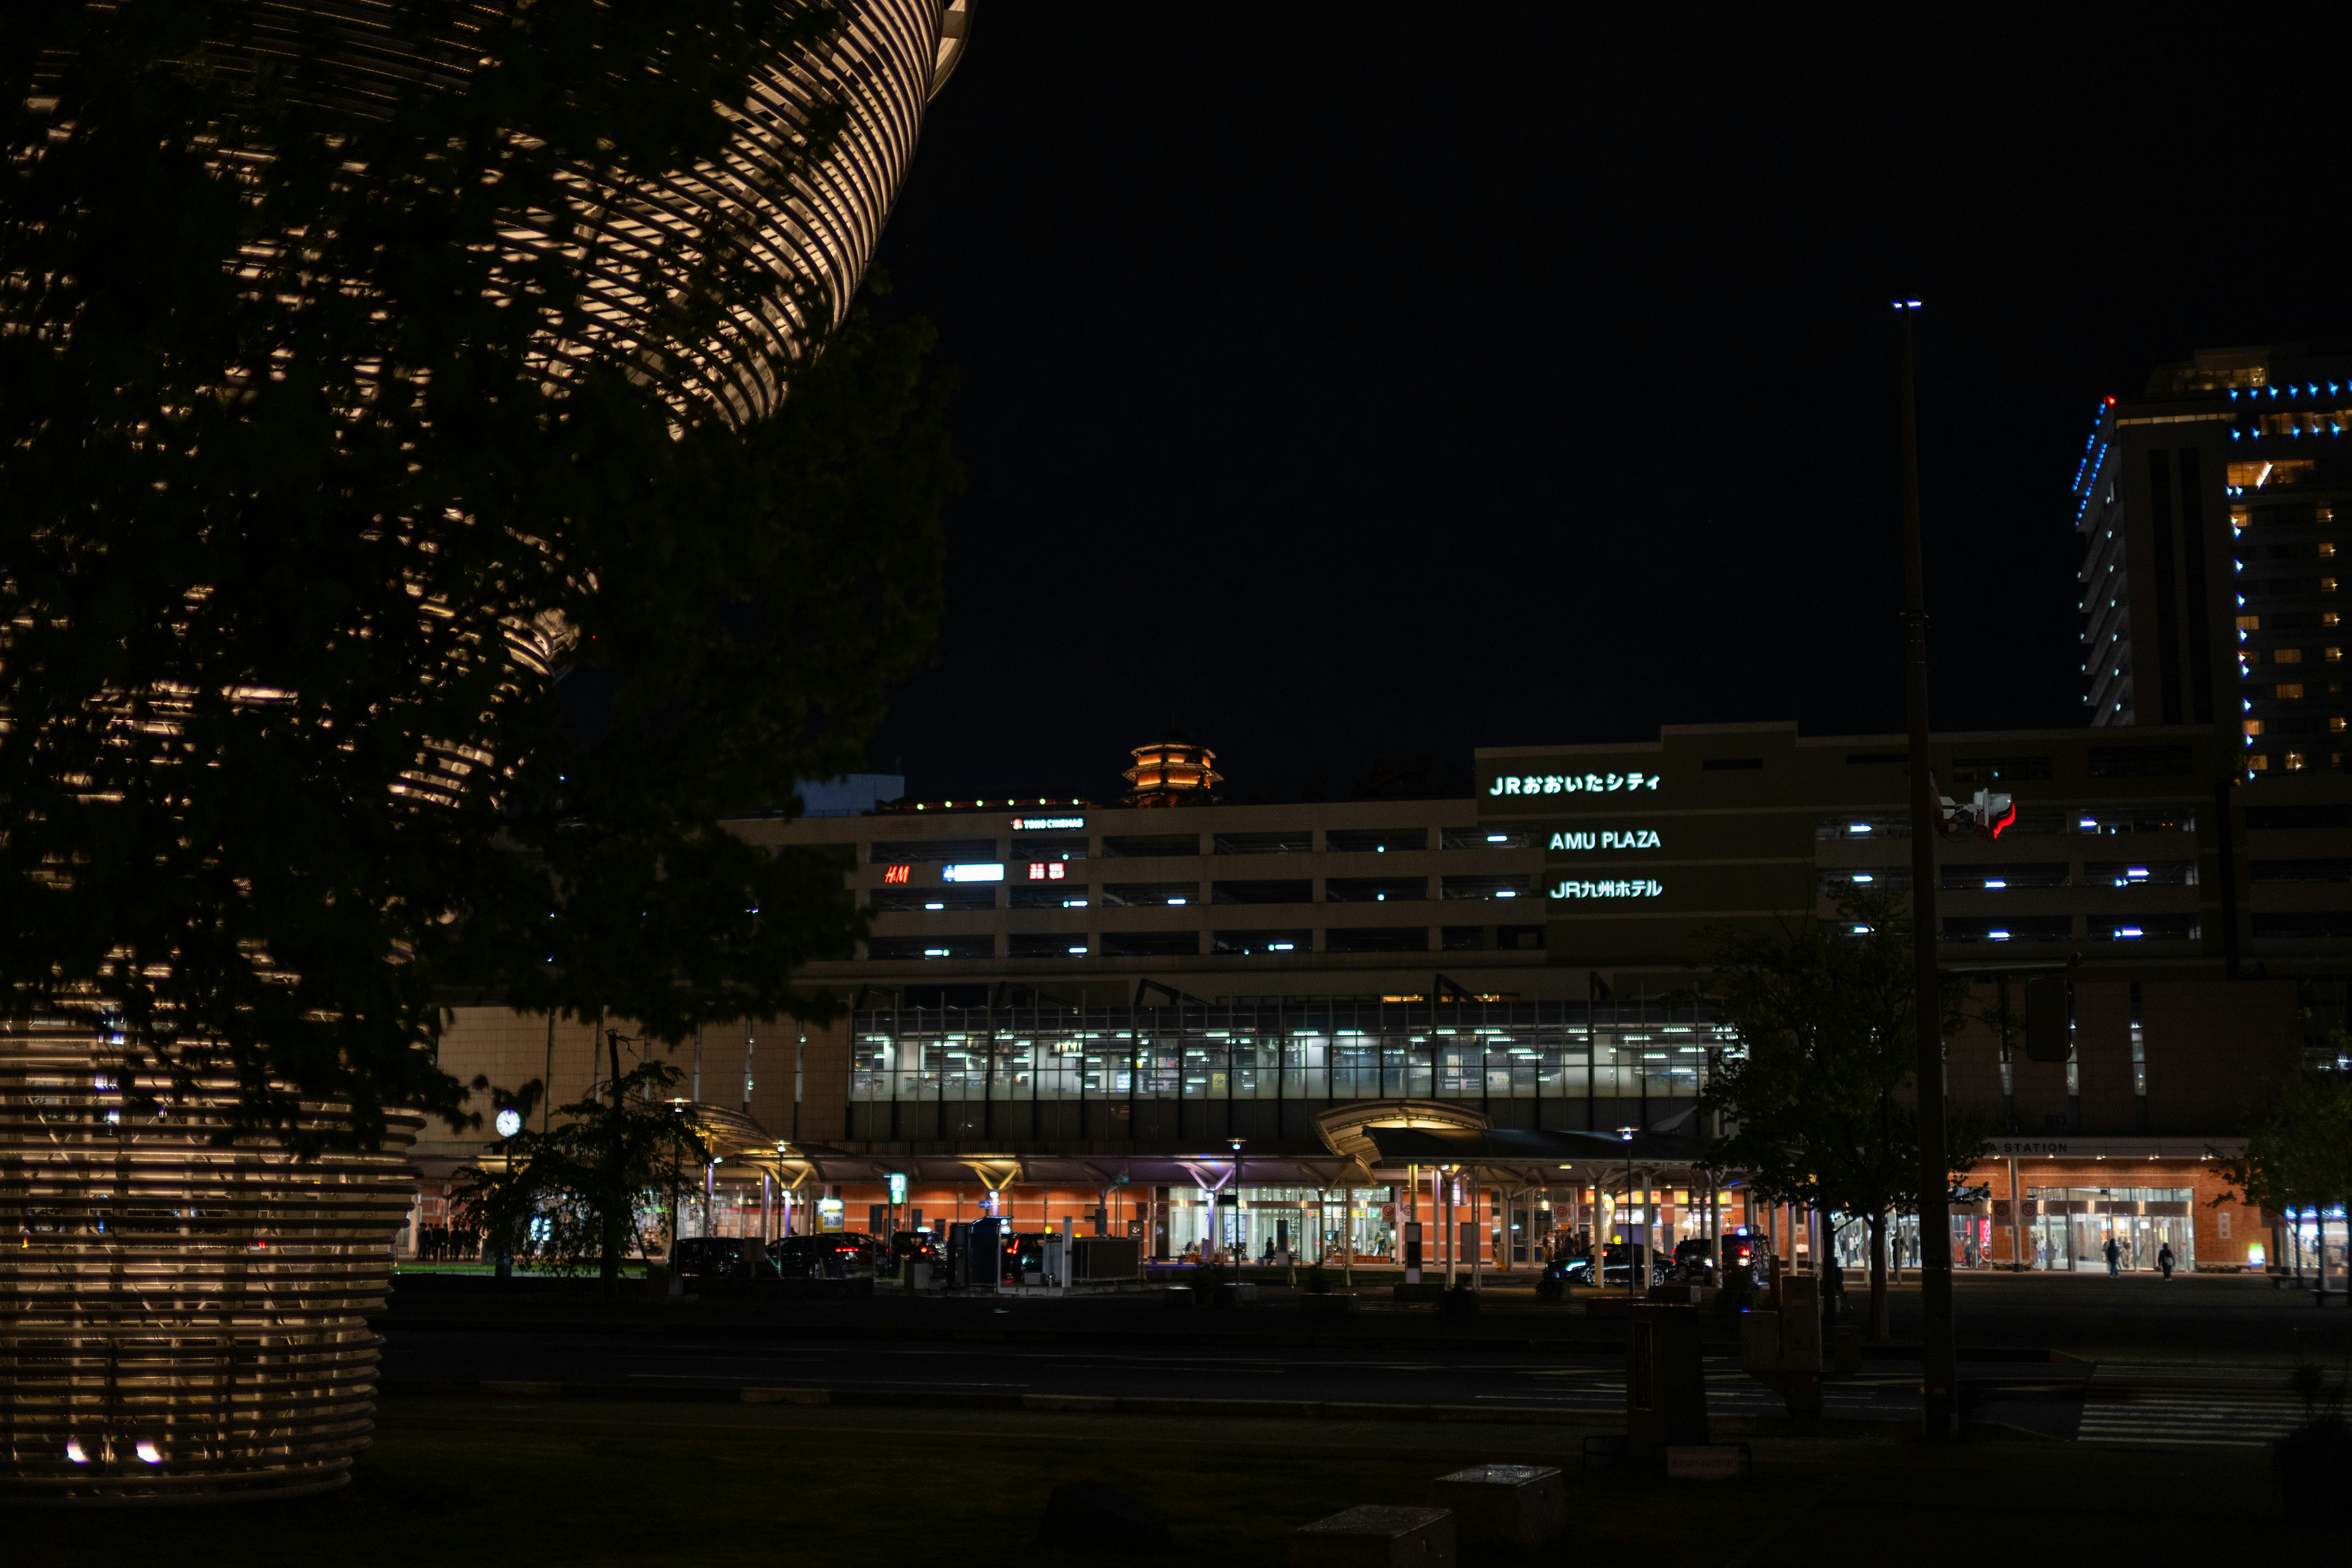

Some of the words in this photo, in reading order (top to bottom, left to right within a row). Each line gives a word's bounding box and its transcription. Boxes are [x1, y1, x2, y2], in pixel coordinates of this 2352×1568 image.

[1489, 772, 1660, 796] JRおおいたシティ
[1023, 819, 1046, 829] TOHO
[1046, 818, 1084, 828] CINEMAS
[1549, 832, 1596, 850] AMU
[1601, 830, 1661, 849] PLAZA
[885, 865, 910, 884] H&M
[1550, 879, 1663, 899] JR九州ホテル
[2004, 1143, 2067, 1152] STATION
